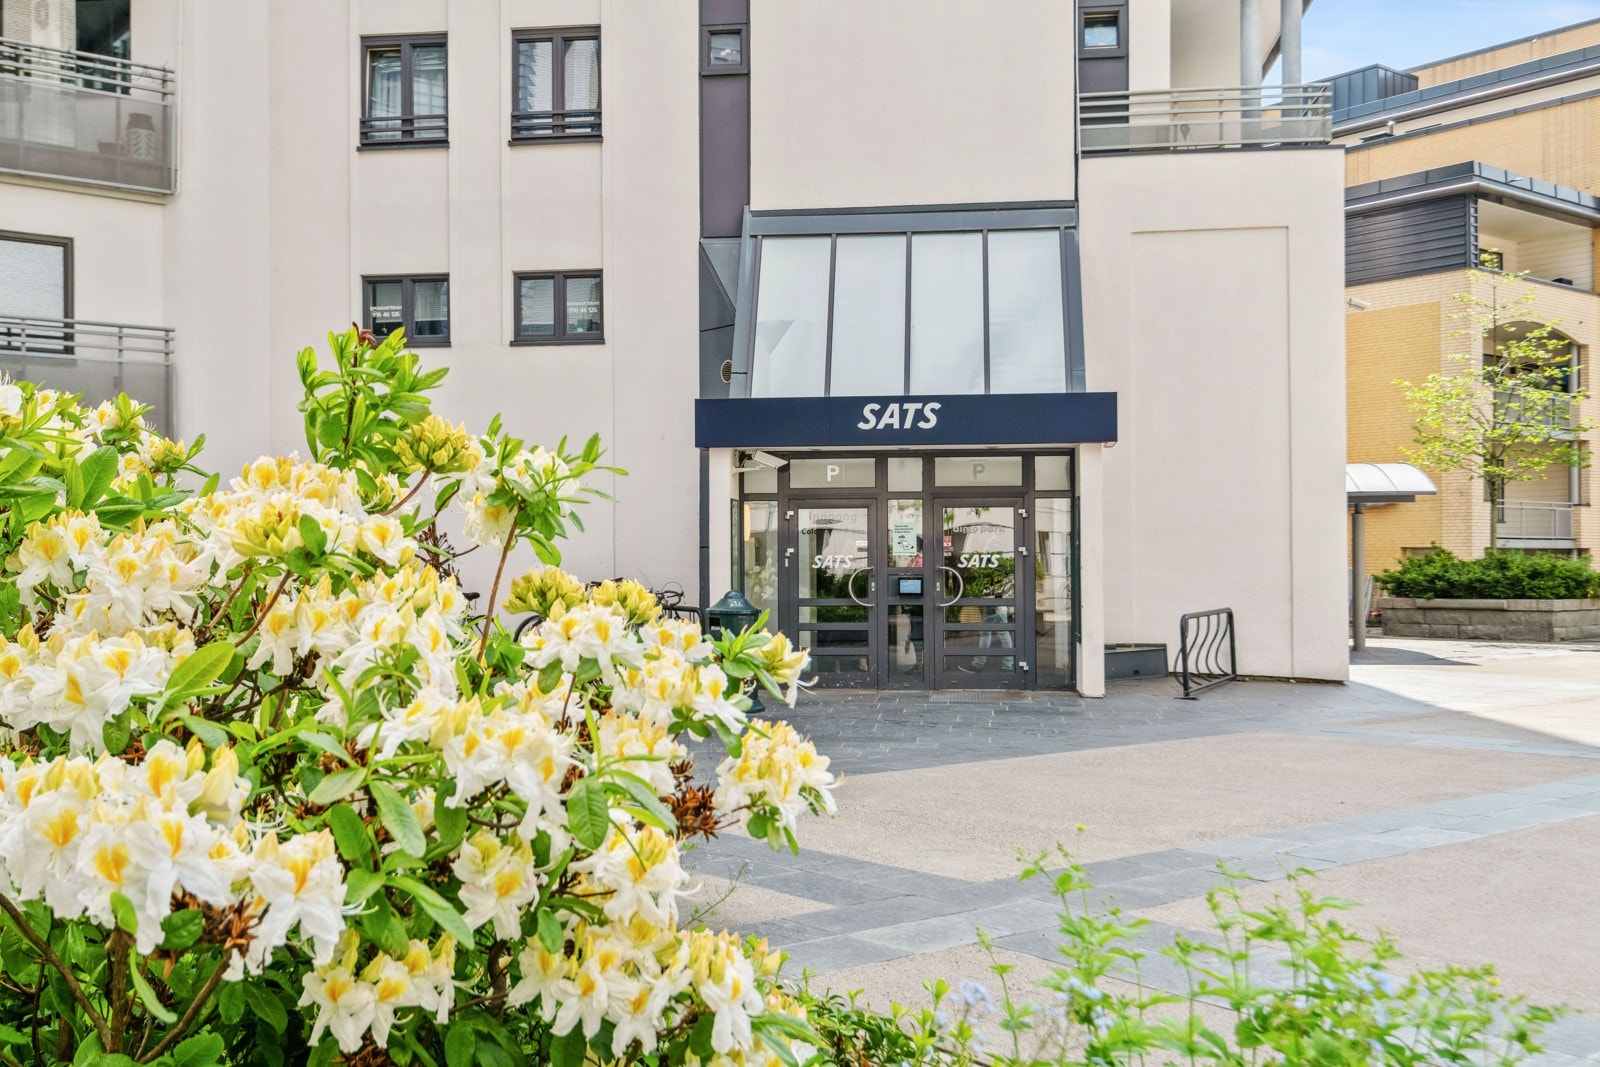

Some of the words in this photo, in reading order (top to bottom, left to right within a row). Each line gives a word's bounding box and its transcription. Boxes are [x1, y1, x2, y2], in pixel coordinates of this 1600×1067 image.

[857, 402, 942, 430] SATS
[826, 464, 840, 482] P
[972, 463, 986, 480] P
[980, 524, 1005, 535] park
[811, 554, 854, 569] SATS
[957, 554, 1000, 568] SATS
